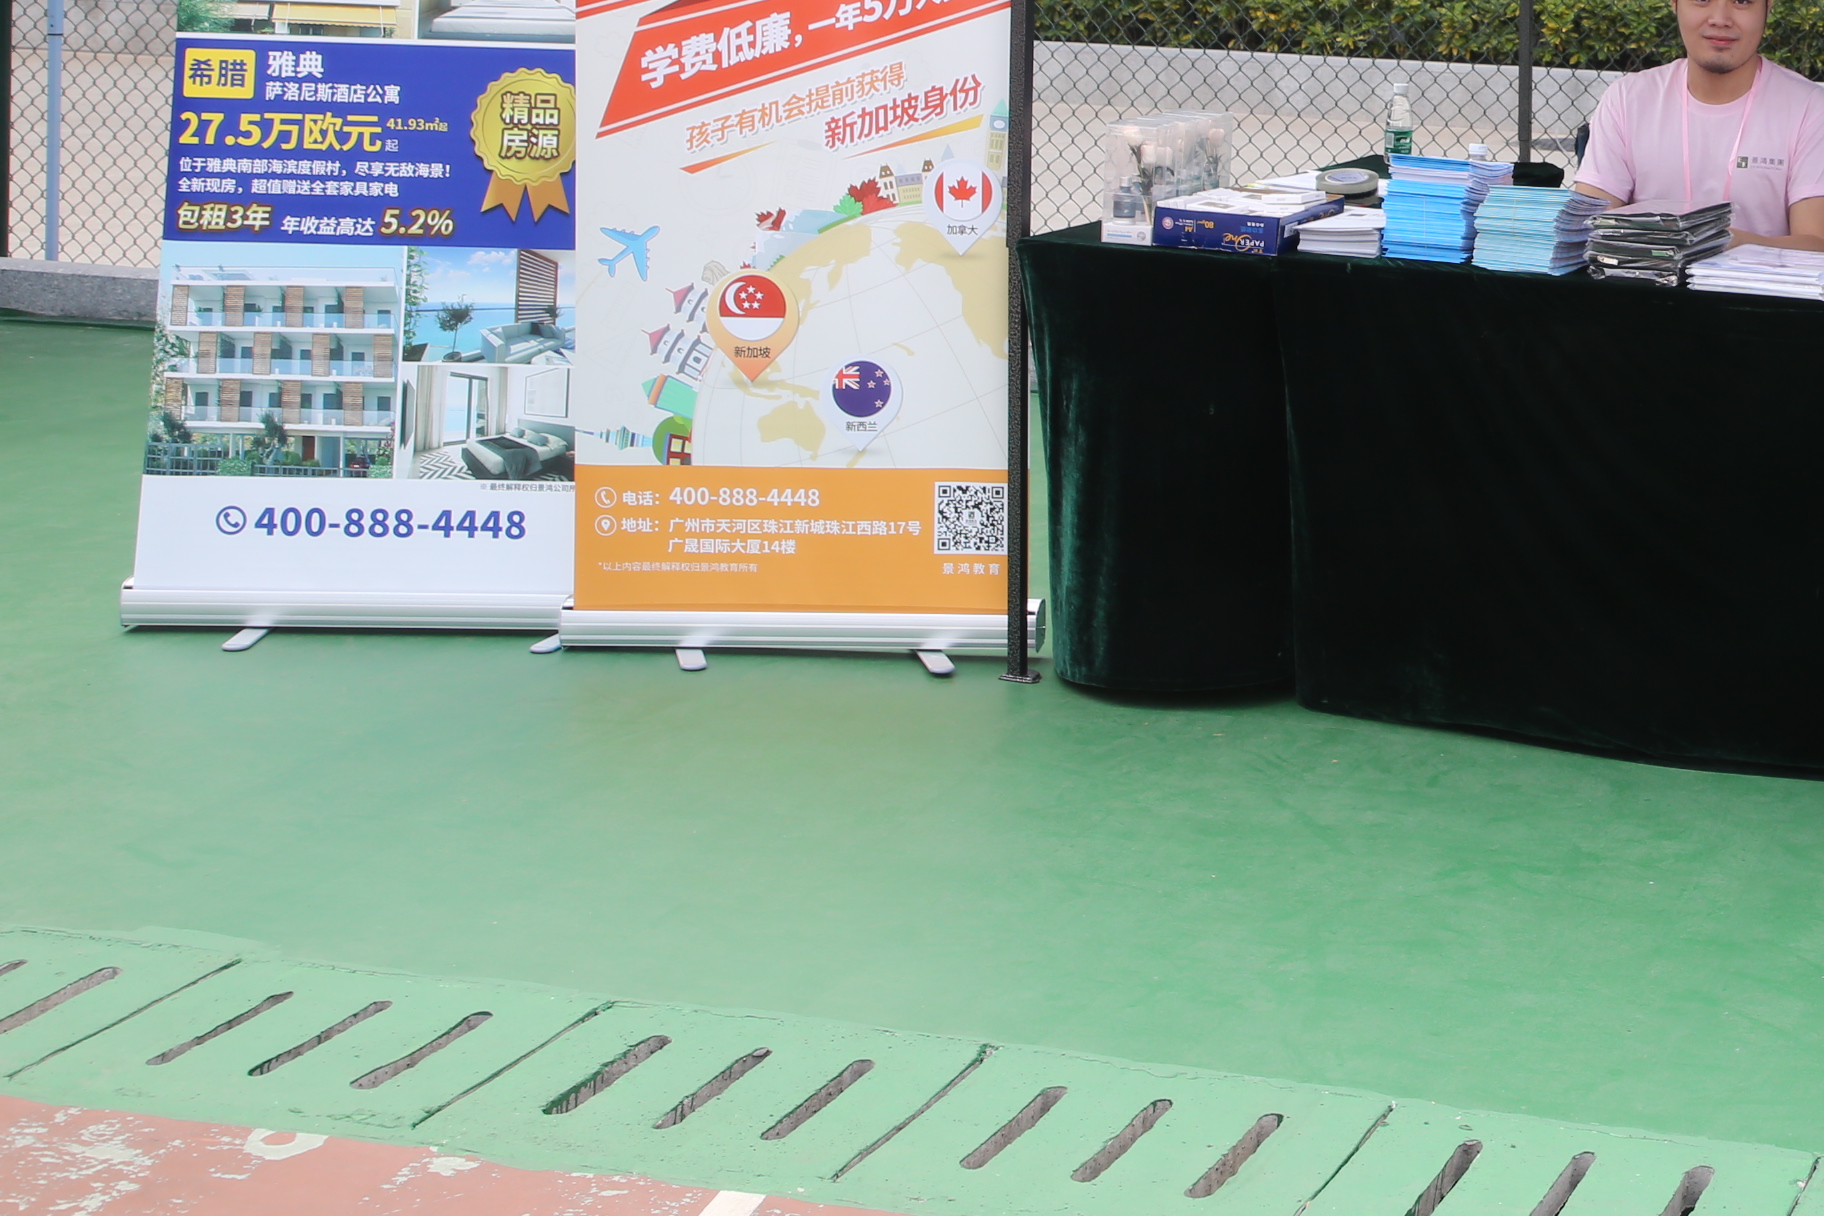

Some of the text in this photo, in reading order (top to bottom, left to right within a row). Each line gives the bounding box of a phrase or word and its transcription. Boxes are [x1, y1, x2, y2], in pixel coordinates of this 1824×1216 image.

[188, 58, 248, 88] 希腊
[267, 51, 324, 79] 雅典
[265, 82, 400, 105] 萨洛尼斯酒店公寓
[686, 62, 905, 152] 孩子有机会提前获得
[501, 93, 560, 125] 精品
[824, 73, 983, 150] 新加坡身份
[178, 111, 383, 152] 27.5万欧元
[500, 129, 559, 159] 房源
[177, 203, 271, 231] 包租3年
[946, 224, 978, 236] 加拿大
[734, 346, 771, 359] 新加坡
[845, 421, 878, 433] 新西兰
[669, 487, 820, 507] 400-888-4448
[254, 507, 527, 540] 400-888-4448
[669, 518, 921, 536] 广州市天河区珠江新城珠江西路17号
[668, 538, 796, 555] 广晟国际大厦14楼
